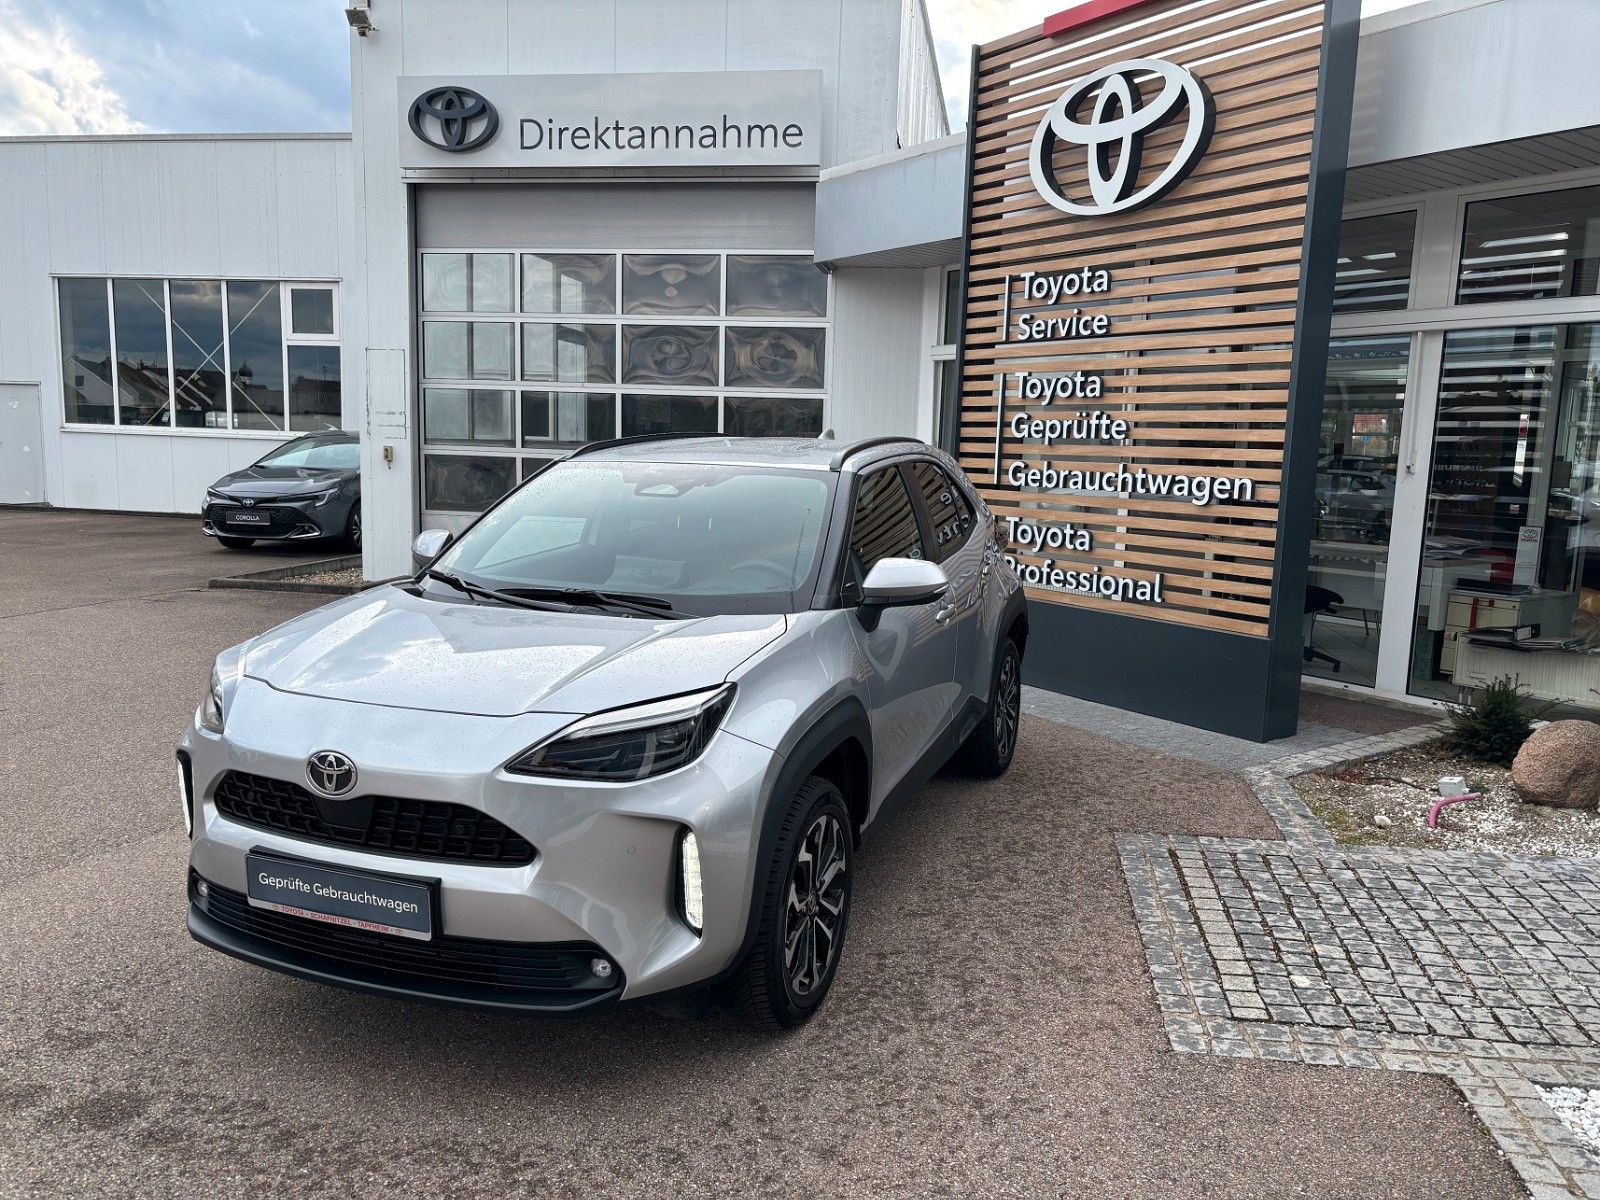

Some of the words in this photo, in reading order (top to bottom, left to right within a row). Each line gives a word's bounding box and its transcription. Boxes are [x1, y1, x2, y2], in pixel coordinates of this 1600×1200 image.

[519, 114, 804, 150] Direktannahme
[1020, 266, 1109, 304] Toyota
[1017, 308, 1109, 340] Service
[1014, 371, 1102, 405] Toyota
[1010, 411, 1128, 445] Geprüfte
[1007, 460, 1254, 506] Gebrauchtwagen
[1006, 516, 1091, 552] Toyota
[258, 872, 311, 893] Geprüfte
[313, 883, 418, 913] Gebrauchtwagen
